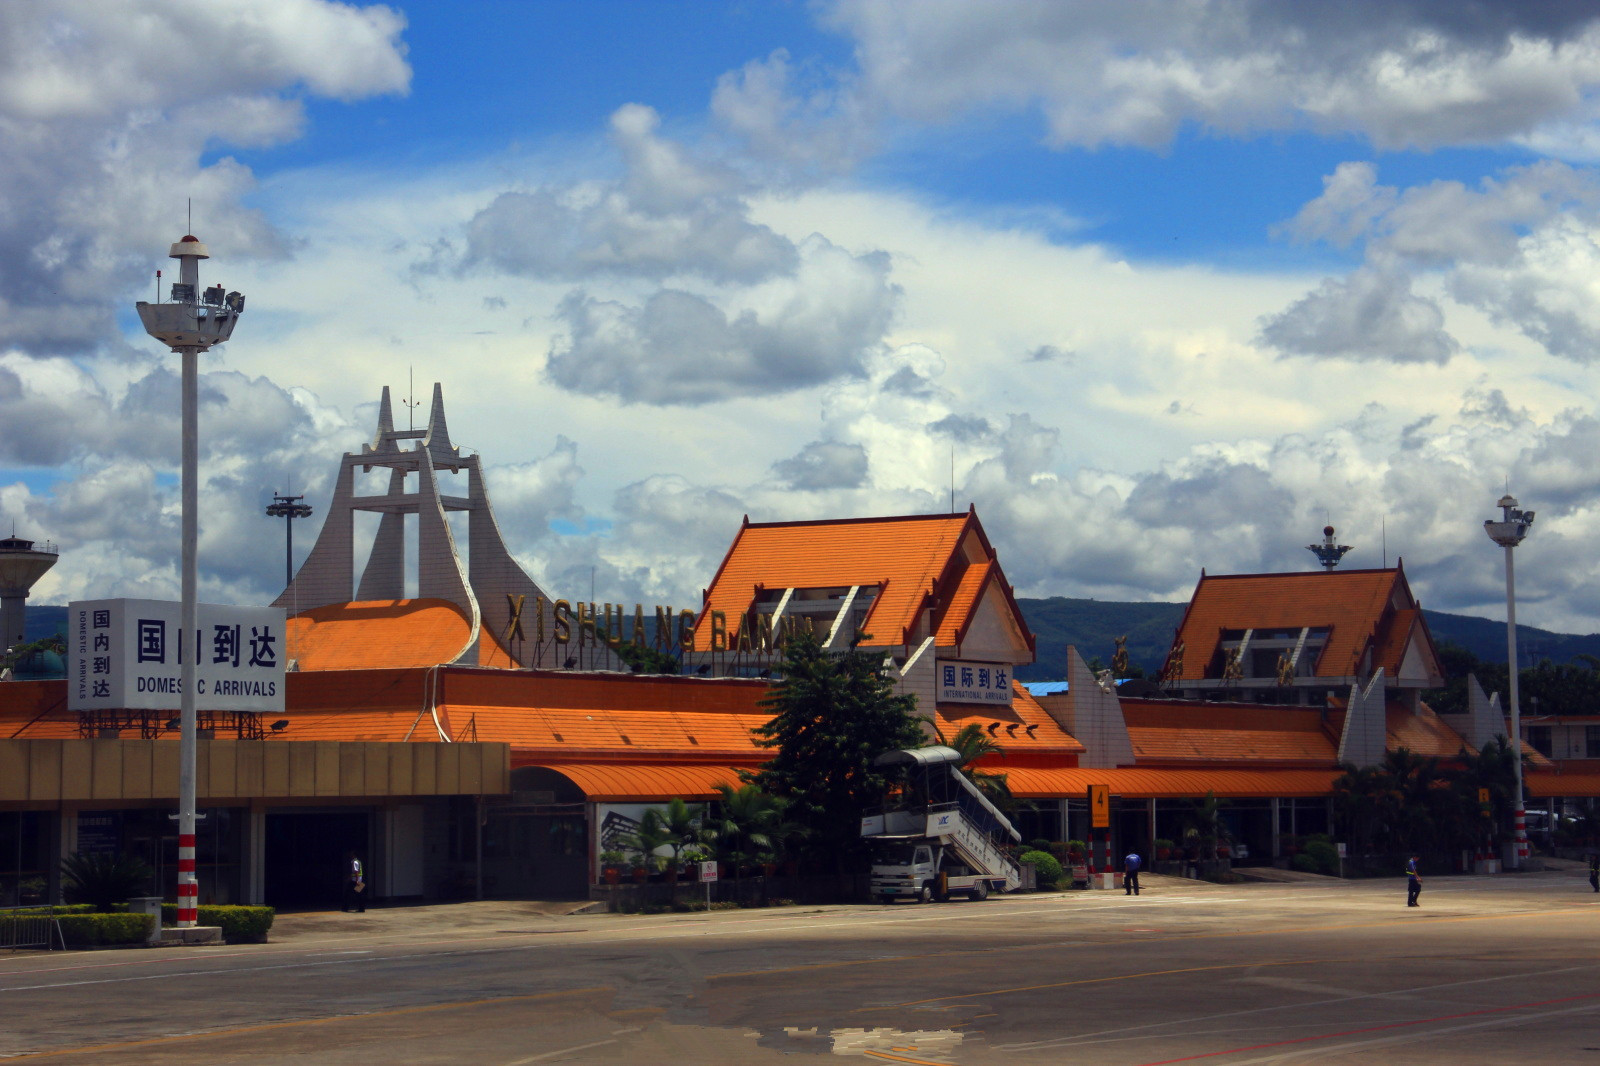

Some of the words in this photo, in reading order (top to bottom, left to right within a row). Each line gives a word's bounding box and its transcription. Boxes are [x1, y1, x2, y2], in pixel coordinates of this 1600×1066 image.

[79, 611, 87, 654] DOMESTIC
[93, 610, 110, 698] 国内到达
[79, 659, 87, 700] ARRIVALS
[137, 677, 206, 695] DOMESC
[214, 680, 276, 697] ARRIVALS
[943, 666, 1007, 689] 国际到达
[943, 690, 982, 699] INTERNATIONAL
[985, 692, 1008, 701] ARRIVALS
